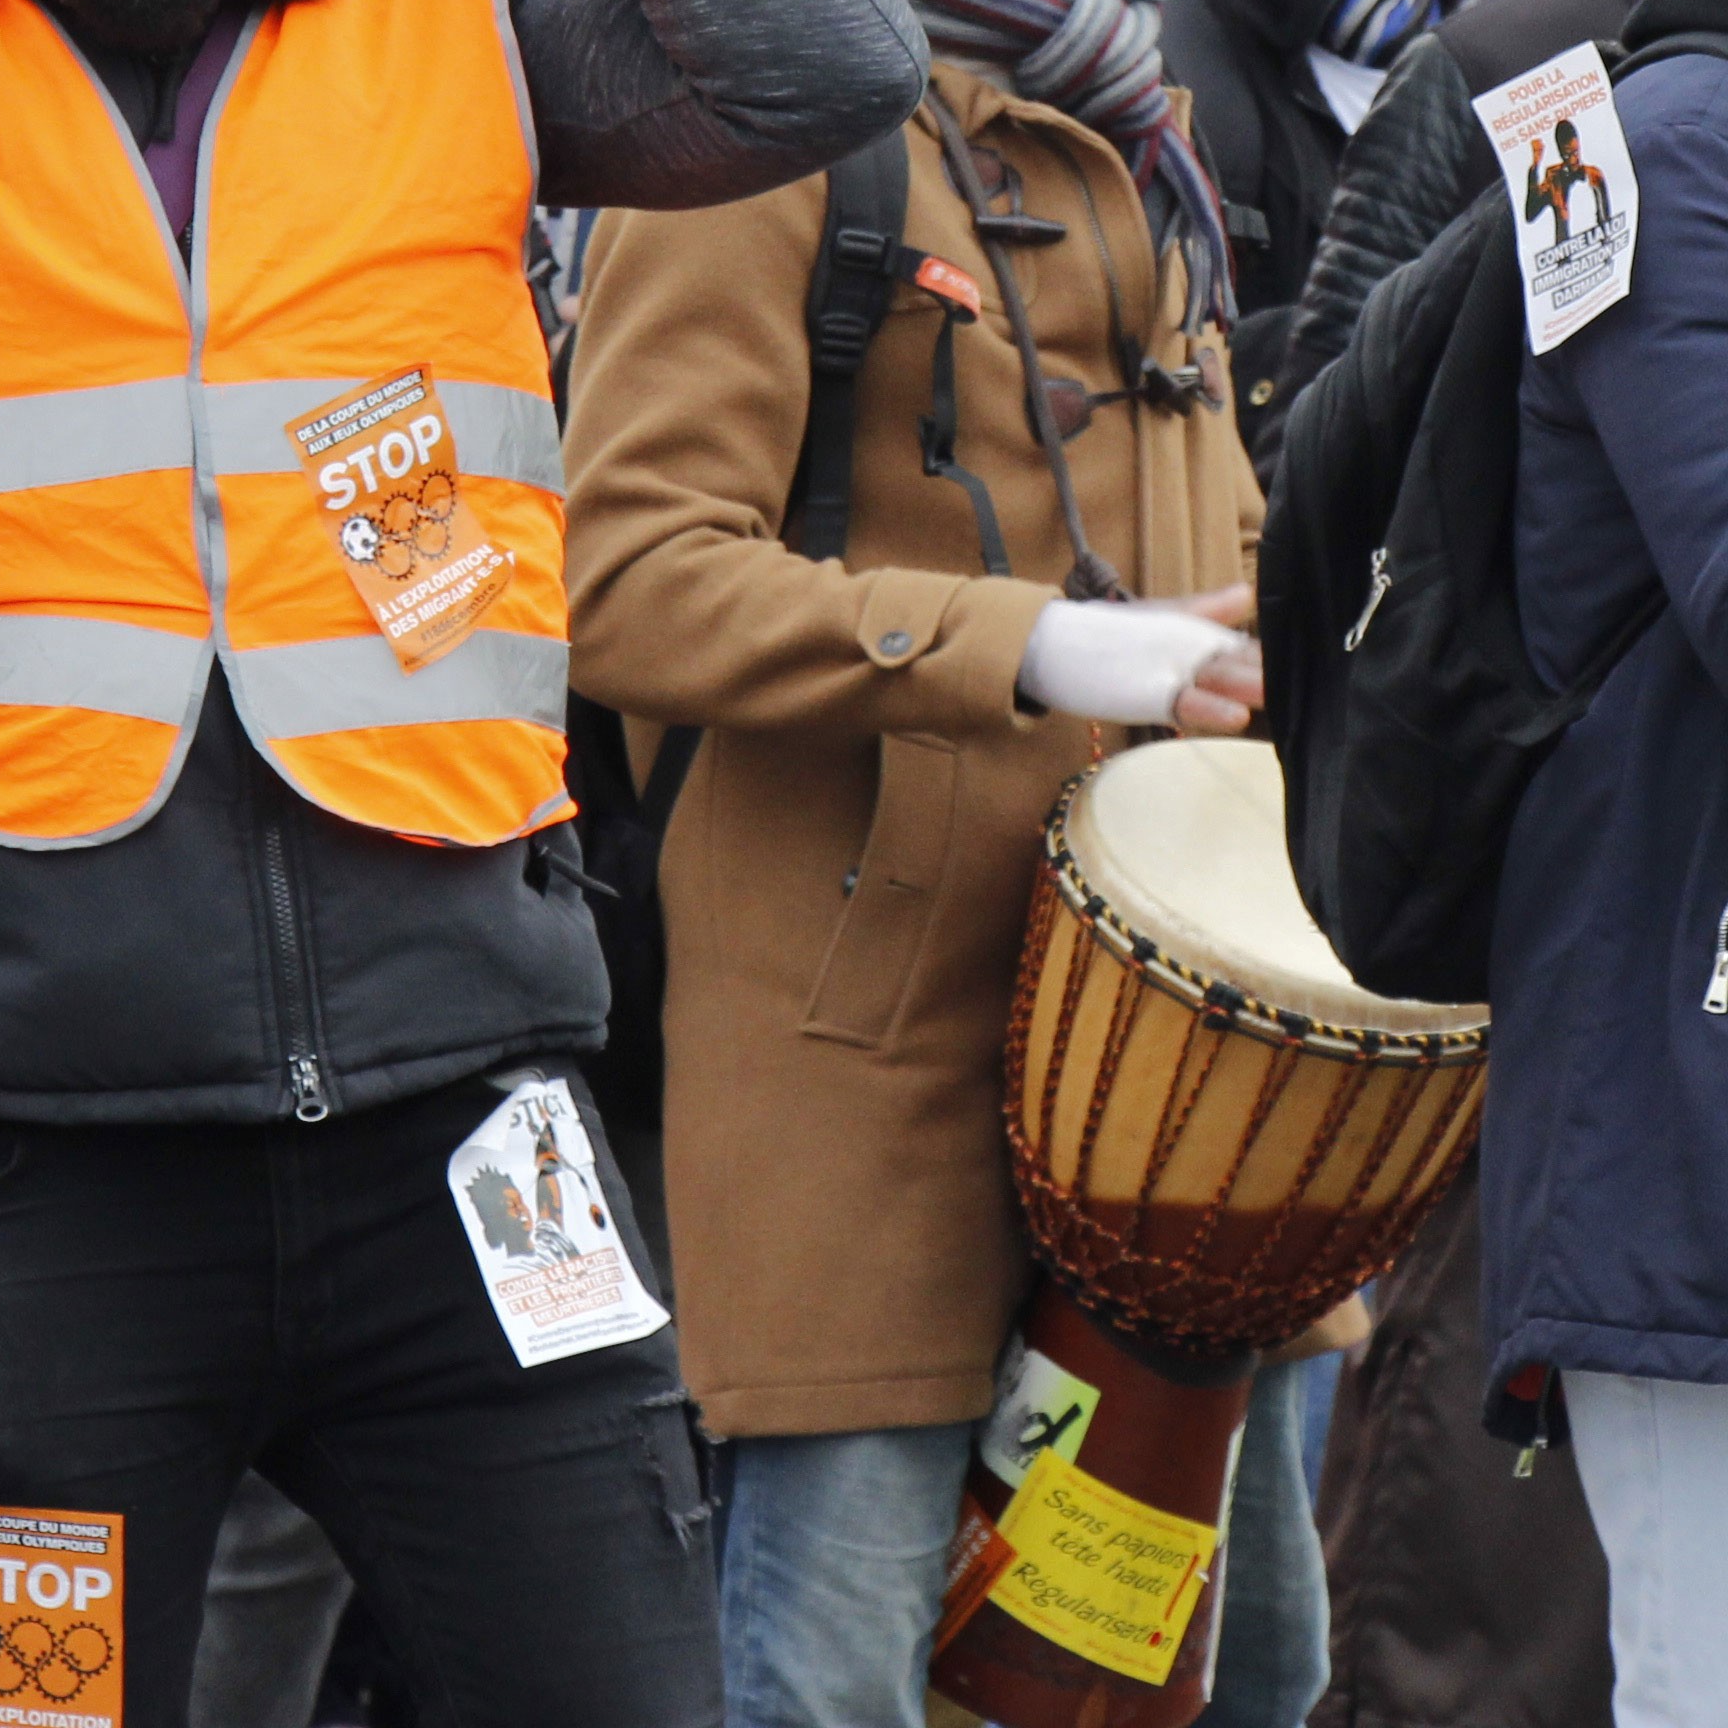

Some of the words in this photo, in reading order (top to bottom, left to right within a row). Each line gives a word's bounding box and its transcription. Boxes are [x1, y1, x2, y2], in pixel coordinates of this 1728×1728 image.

[1508, 76, 1546, 103] POUR
[1547, 68, 1566, 85] LA
[1534, 242, 1612, 293] IMMIGRATION
[1537, 232, 1588, 268] CONTRE
[1586, 224, 1605, 243] LA
[296, 426, 315, 442] DE
[313, 418, 331, 434] LA
[328, 400, 368, 426] COUPE
[366, 392, 384, 407] DU
[382, 370, 422, 399] MONDE
[308, 433, 333, 456] AUX
[333, 422, 361, 443] JEUX
[359, 387, 425, 429] OLYMPIQUES
[319, 414, 442, 510] STOP
[377, 602, 393, 622] À
[388, 544, 494, 615] L'EXPLOITATION
[389, 612, 419, 639] DES
[498, 1272, 549, 1296] CONTRE
[548, 1261, 567, 1281] LE
[509, 1299, 527, 1314] ET
[524, 1292, 550, 1309] LES
[22, 1534, 107, 1554] OLYMPIQUES
[39, 1520, 59, 1534] DU
[60, 1523, 110, 1539] MONDE
[1044, 1489, 1110, 1535] Sans
[1103, 1532, 1191, 1570] papiers
[1012, 1561, 1175, 1653] Régularisatin
